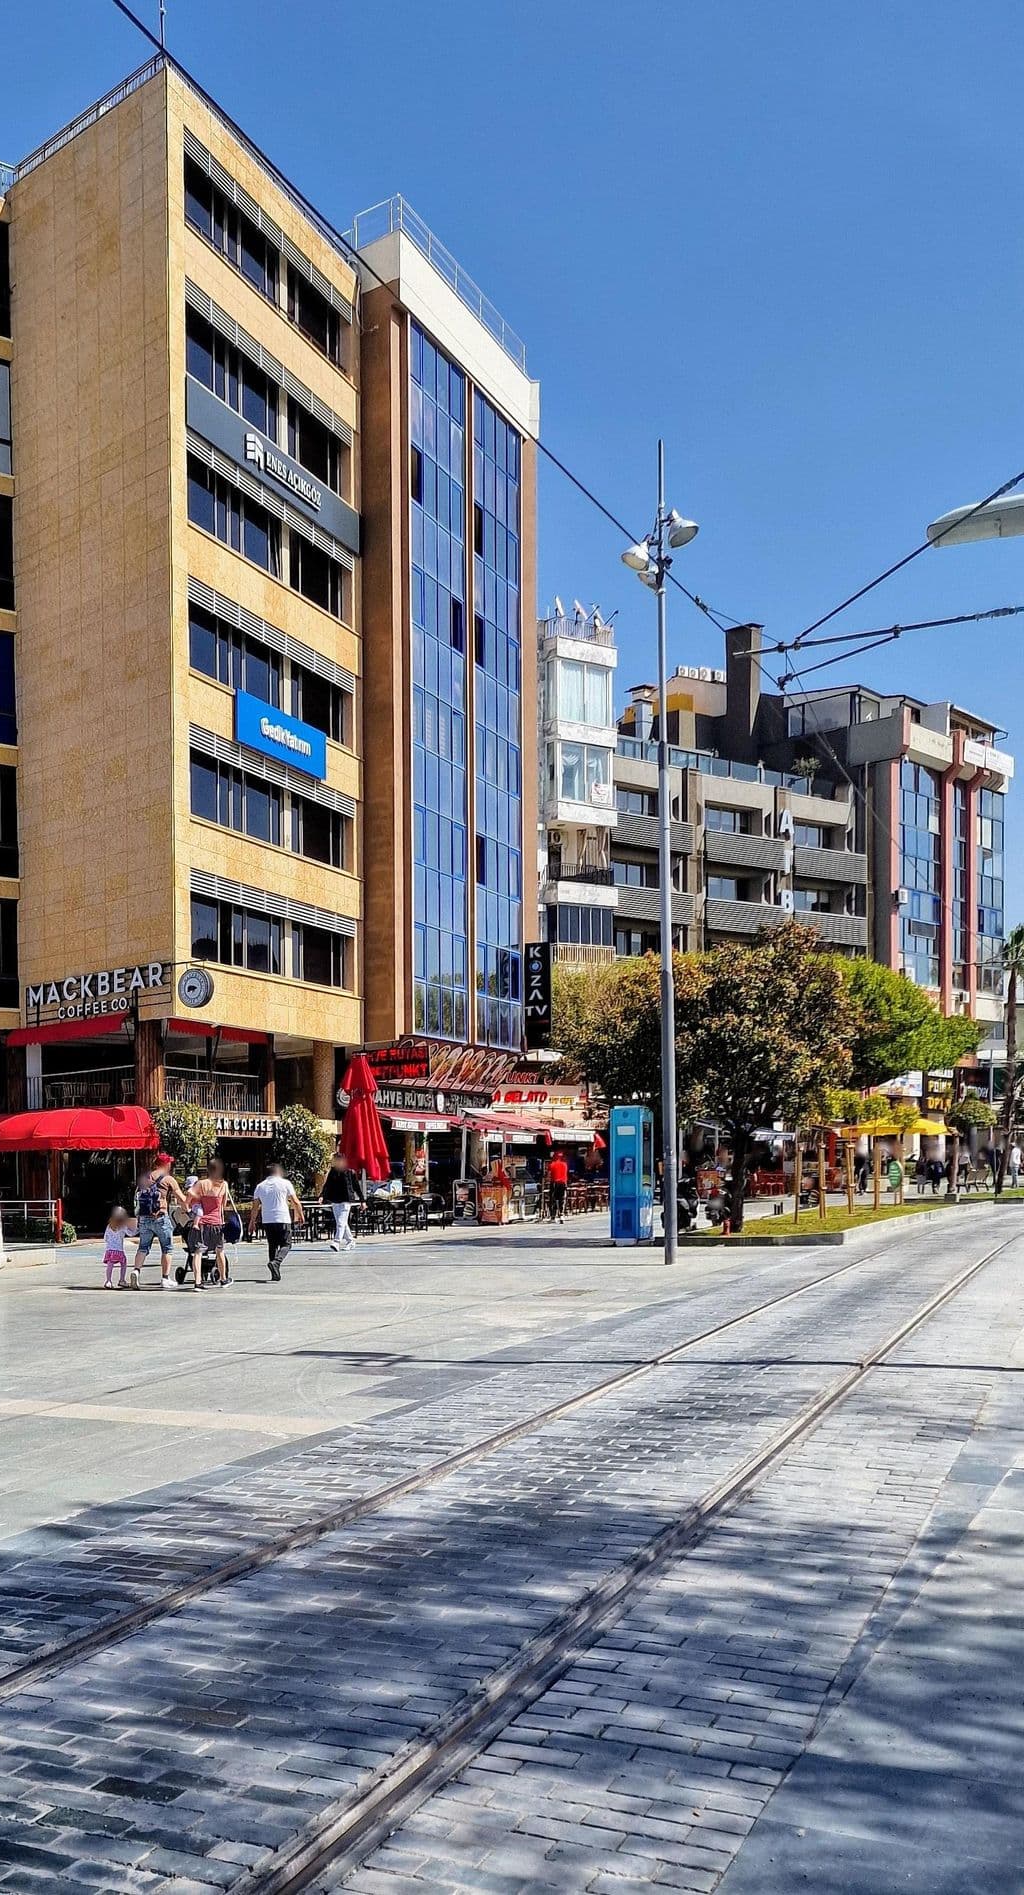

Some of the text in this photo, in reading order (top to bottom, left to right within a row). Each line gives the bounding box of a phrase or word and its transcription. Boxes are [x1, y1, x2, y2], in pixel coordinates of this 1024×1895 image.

[266, 451, 322, 507] ENES AÇIKGÖZ
[28, 962, 164, 1008] MACKBEAR
[58, 1001, 108, 1019] COFFEE
[525, 1004, 548, 1017] TV
[233, 1118, 273, 1132] COFFEE
